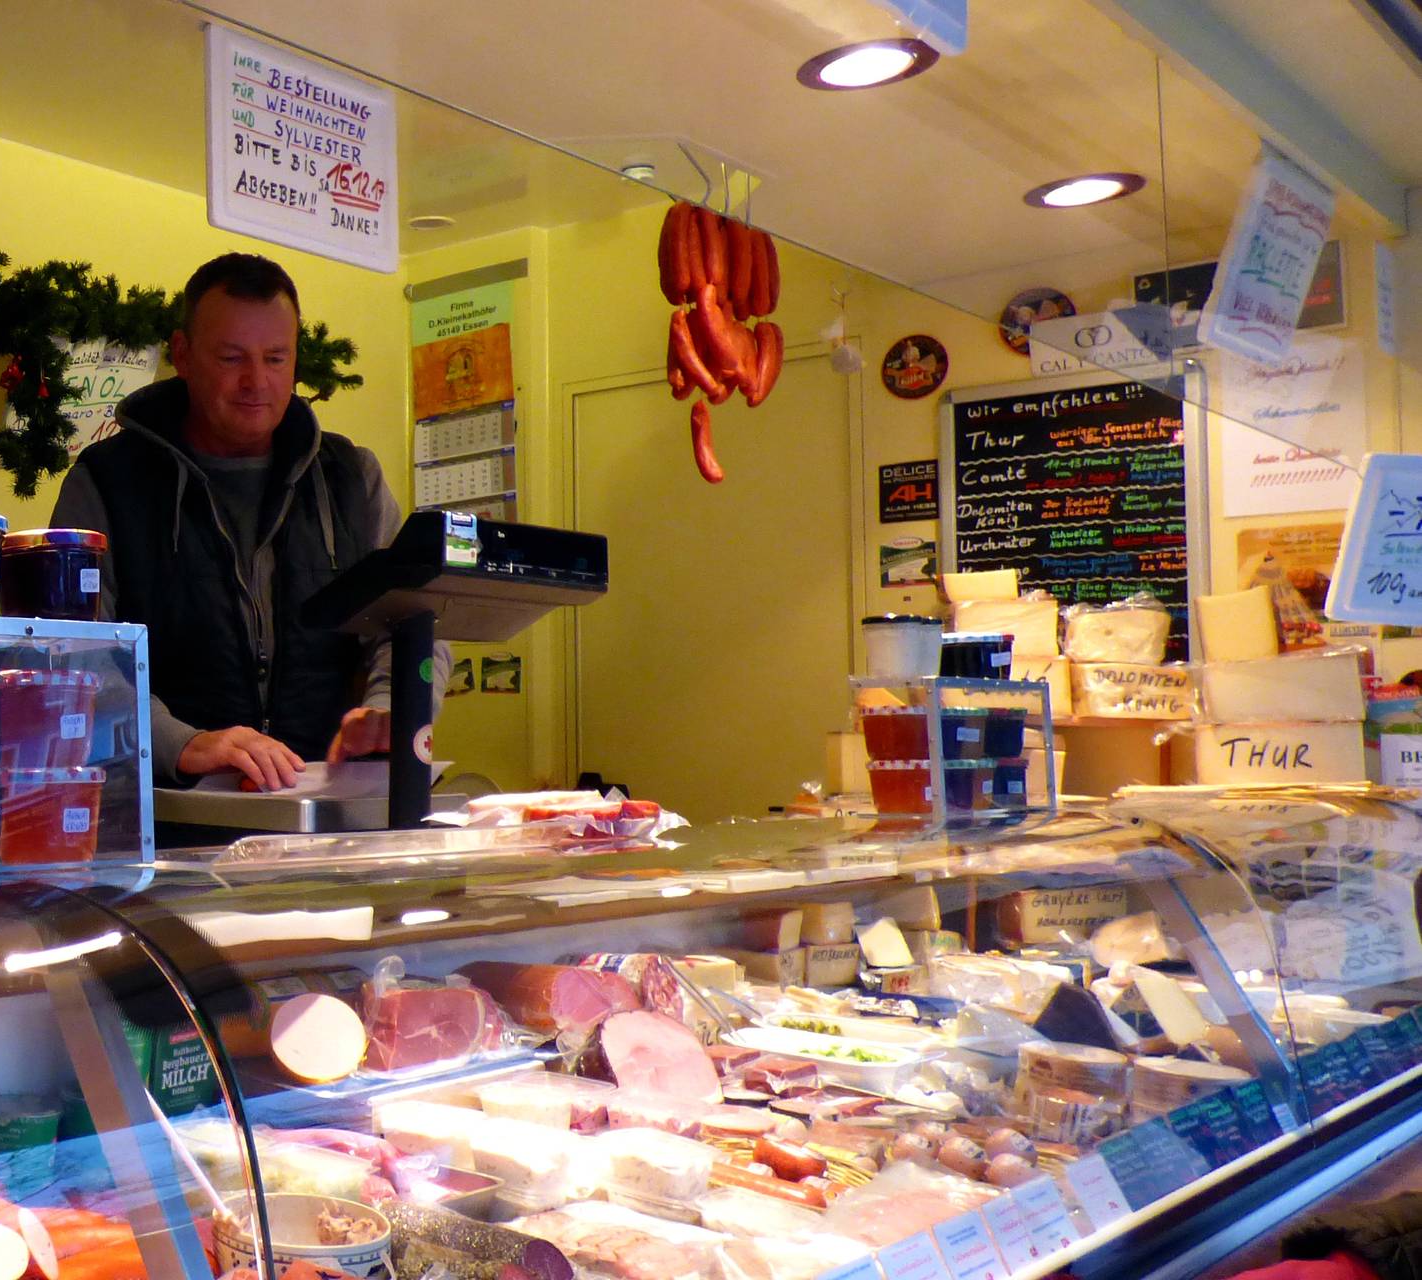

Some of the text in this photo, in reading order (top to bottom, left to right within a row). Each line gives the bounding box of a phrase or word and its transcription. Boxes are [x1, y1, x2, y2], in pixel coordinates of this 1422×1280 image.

[233, 51, 372, 120] IHRE BESTELLUNG
[232, 82, 366, 141] FÜR WEIHNACHTEN
[232, 109, 362, 166] UND SYLVESTER
[450, 300, 474, 313] Firma
[462, 319, 489, 332] Essen
[966, 430, 1025, 451] Thur
[961, 463, 1028, 486] Comté
[957, 501, 1033, 519] Dolomiten
[1220, 737, 1314, 769] THUR
[161, 1062, 211, 1090] MILCH
